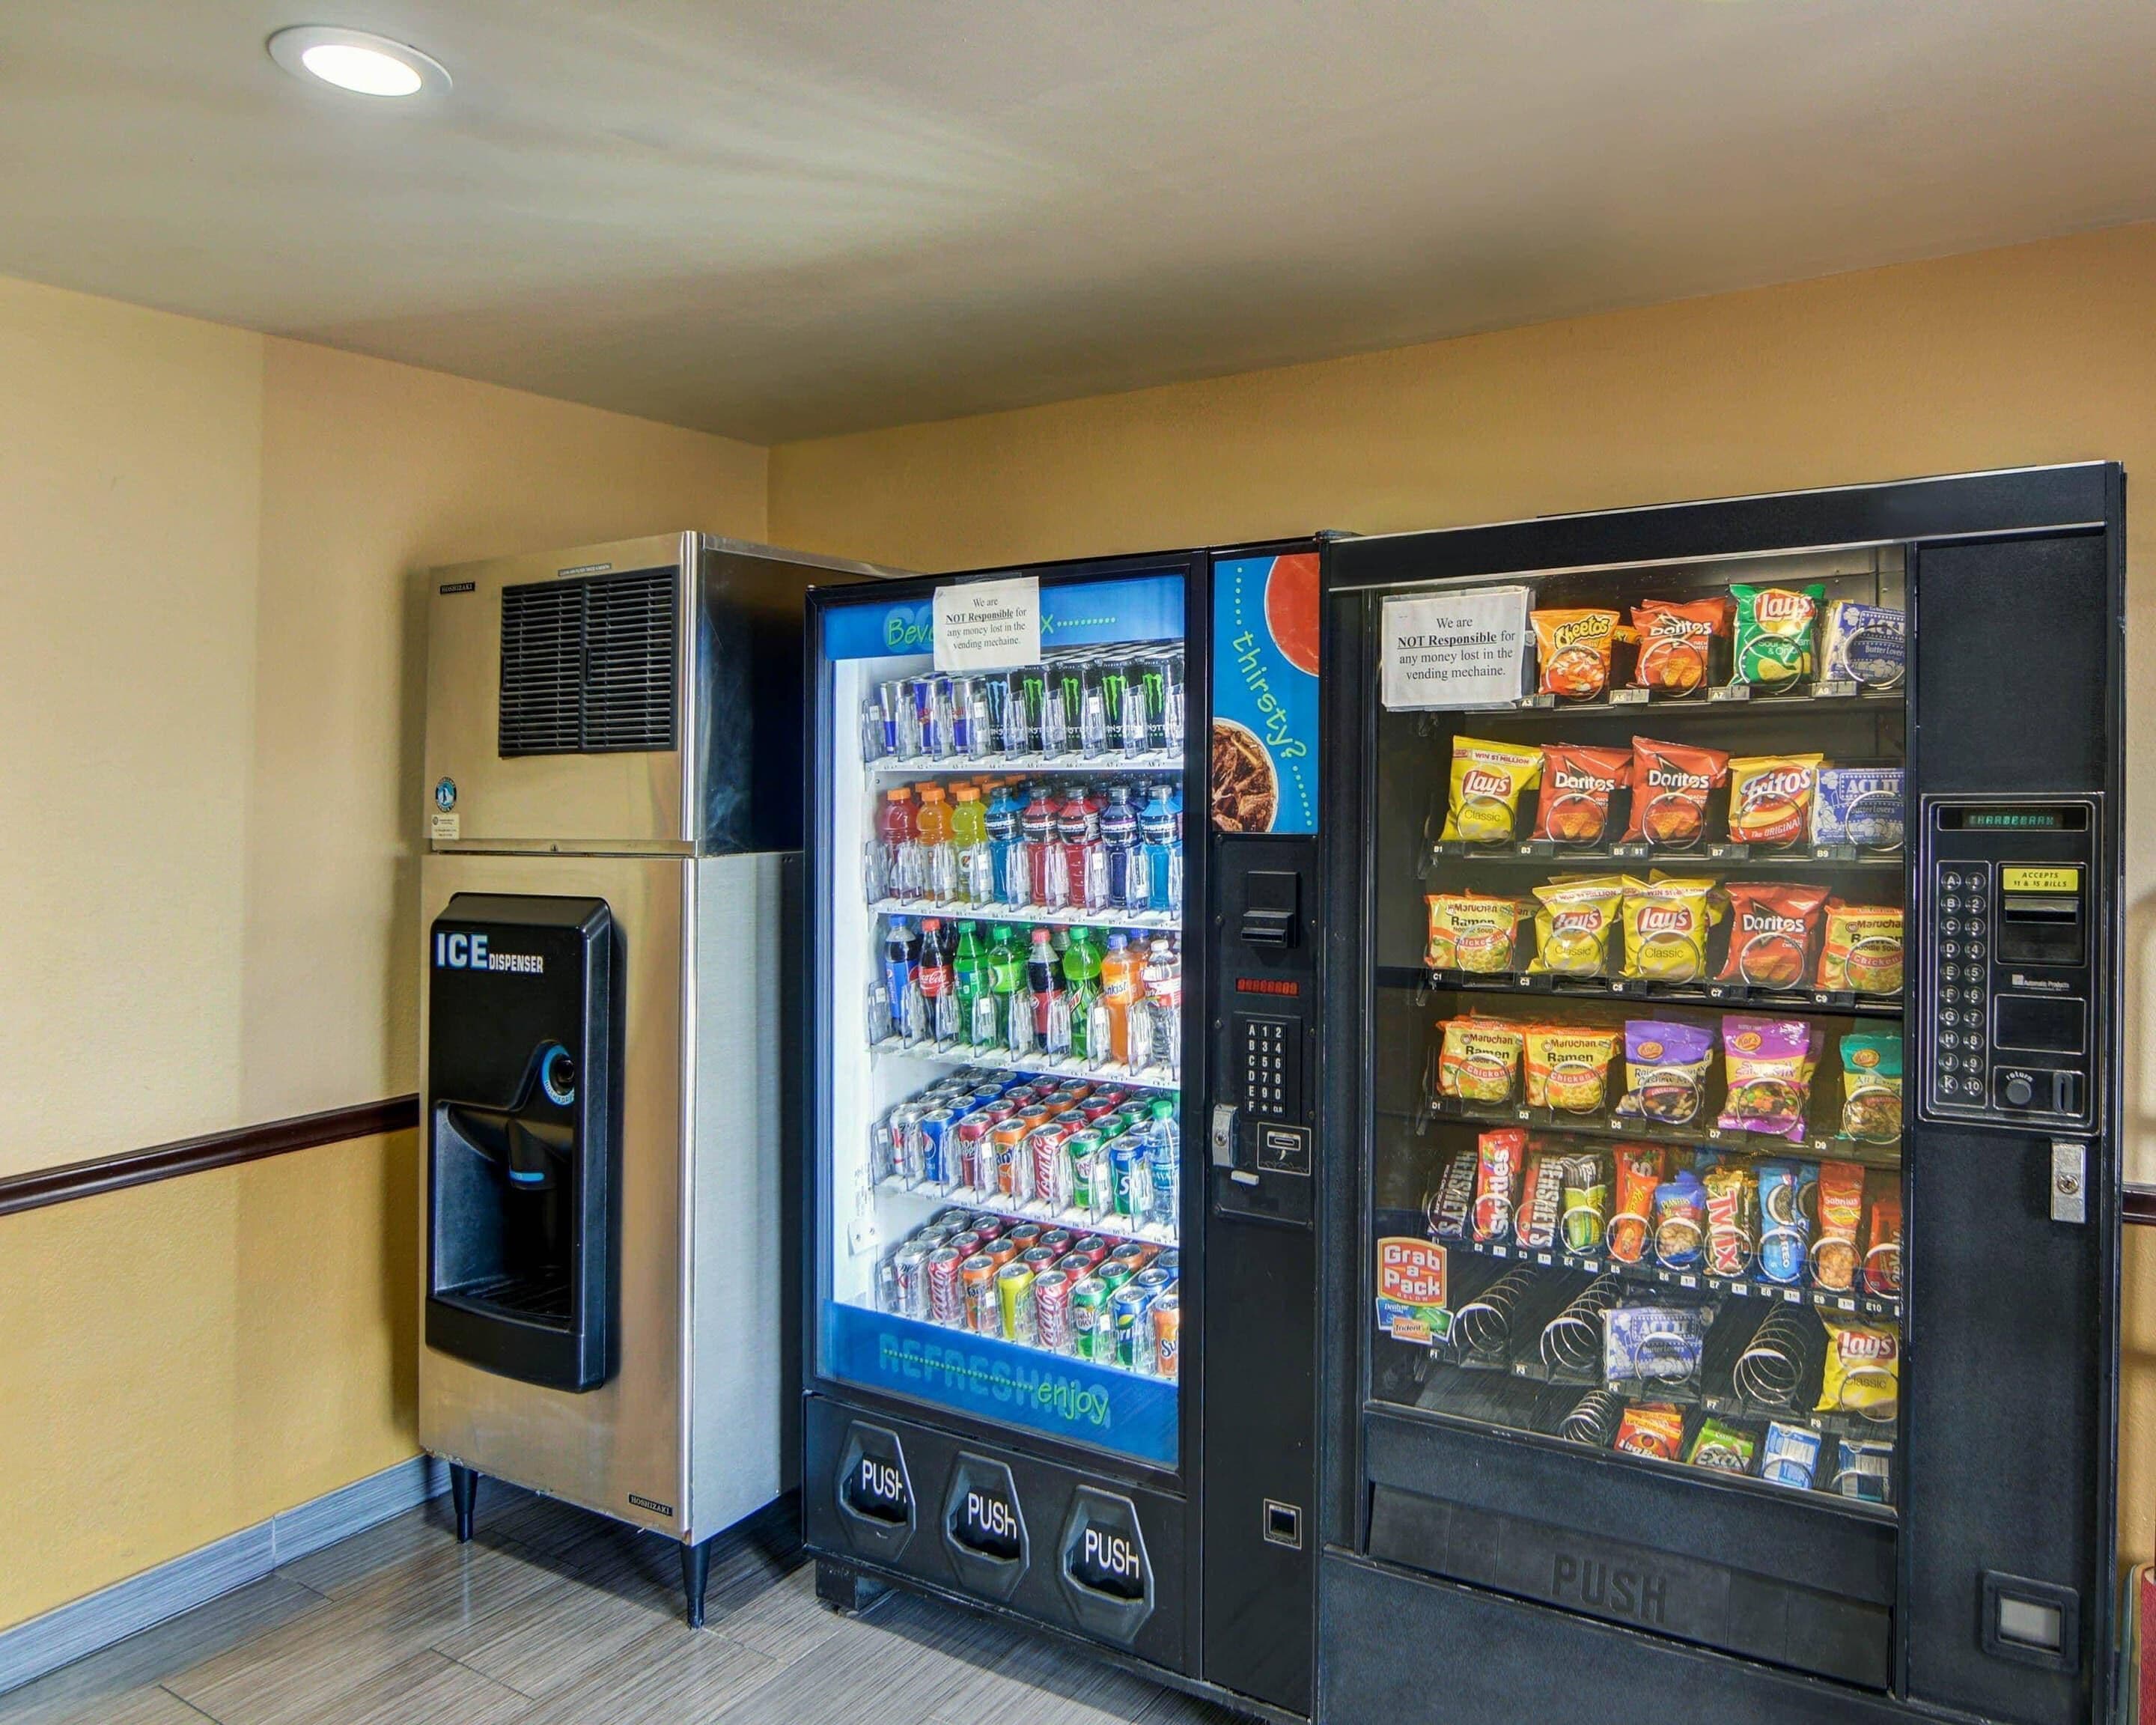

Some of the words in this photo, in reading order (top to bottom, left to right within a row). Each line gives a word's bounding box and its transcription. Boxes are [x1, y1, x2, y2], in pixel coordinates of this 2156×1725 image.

[973, 599, 985, 607] We
[945, 613, 966, 624] NOT
[969, 608, 1014, 622] Responsible
[1016, 607, 1026, 617] for
[1436, 618, 1453, 629] We
[1456, 618, 1473, 627] are
[1650, 620, 1713, 636] Doritos
[947, 629, 962, 638] any
[963, 627, 988, 636] money
[990, 624, 1003, 633] lost
[1005, 623, 1012, 631] in
[1014, 621, 1026, 630] the
[1554, 615, 1610, 650] Cheetos
[953, 639, 982, 650] vending
[1398, 636, 1425, 648] NOT
[1429, 632, 1497, 647] Responsible
[1501, 630, 1515, 642] for
[1865, 645, 1886, 654] Butter
[1399, 655, 1418, 666] any
[1421, 652, 1457, 663] money
[1461, 649, 1480, 660] lost
[1483, 648, 1493, 659] in
[1497, 648, 1513, 658] the
[1406, 668, 1448, 681] vending
[1451, 666, 1506, 678] mechaine.
[1233, 630, 1307, 758] thirsty?
[1499, 755, 1529, 764] MILLION
[1464, 770, 1510, 796] Lay's
[1555, 772, 1616, 791] Doritos
[1649, 770, 1710, 788] Doritos
[1741, 768, 1811, 798] Fritos
[1846, 779, 1880, 794] ACT
[1881, 779, 1900, 793] II
[1464, 809, 1500, 821] Classic
[1521, 845, 1531, 854] B3
[1613, 848, 1624, 856] B5
[1712, 848, 1723, 857] B7
[1947, 876, 1955, 885] A
[1973, 877, 1978, 885] 1
[1973, 900, 1979, 908] 2
[1640, 907, 1688, 932] Lay's
[1743, 913, 1806, 933] Doritos
[1857, 919, 1904, 928] Marucha
[1946, 921, 1955, 930] C
[1972, 922, 1979, 931] 3
[436, 933, 487, 968] ICE
[489, 953, 543, 973] DISPENSER
[1555, 944, 1591, 956] Classic
[1645, 948, 1684, 959] Classic
[1947, 944, 1955, 952] D
[1972, 945, 1978, 954] 4
[1433, 973, 1442, 981] C1
[1947, 967, 1954, 975] E
[1972, 968, 1978, 976] 5
[1520, 978, 1529, 986] C3
[1711, 989, 1722, 997] C7
[1815, 994, 1827, 1003] C9
[1946, 989, 1954, 997] F
[1971, 990, 1978, 999] 6
[1945, 1011, 1954, 1020] G
[1971, 1013, 1978, 1021] 7
[1249, 1024, 1255, 1036] A
[1262, 1025, 1267, 1036] 1
[1276, 1027, 1281, 1038] 2
[1470, 1033, 1513, 1044] Maruchan
[1551, 1038, 1596, 1048] Maruchan
[1946, 1035, 1954, 1043] H
[1970, 1035, 1977, 1045] 8
[1249, 1040, 1255, 1050] B
[1262, 1041, 1267, 1052] 3
[1276, 1043, 1281, 1053] 4
[1466, 1045, 1510, 1059] Ramen
[1249, 1055, 1255, 1066] C
[1262, 1056, 1267, 1067] 5
[1276, 1059, 1280, 1069] 6
[1547, 1052, 1593, 1062] Ramen
[1946, 1057, 1952, 1065] J
[1970, 1059, 1976, 1068] 9
[1467, 1065, 1505, 1078] Chicken
[1550, 1071, 1591, 1083] Chicken
[2006, 1071, 2033, 1082] return
[1249, 1071, 1255, 1081] D
[1262, 1072, 1267, 1083] 7
[1276, 1074, 1280, 1084] 8
[1945, 1080, 1953, 1089] K
[1967, 1081, 1979, 1090] 10
[1249, 1086, 1254, 1096] E
[1262, 1087, 1267, 1098] 9
[1276, 1089, 1280, 1100] 0
[1249, 1101, 1254, 1112] F
[1815, 1141, 1827, 1149] D9
[1384, 1245, 1440, 1271] Grab
[1407, 1266, 1419, 1277] a
[1384, 1268, 1440, 1297] Pack
[1384, 1303, 1409, 1313] Dentyne
[1866, 1303, 1881, 1311] E10
[1842, 1331, 1892, 1359] Lay's
[1430, 1351, 1437, 1359] F1
[1037, 1381, 1109, 1426] enjoy
[1706, 1402, 1717, 1410] F7
[1811, 1419, 1821, 1428] F9
[631, 1496, 670, 1514] HOSHIZAKI
[968, 1492, 1017, 1539] PUSH
[1085, 1529, 1139, 1579] PUSH
[1551, 1554, 1666, 1623] PUSH
